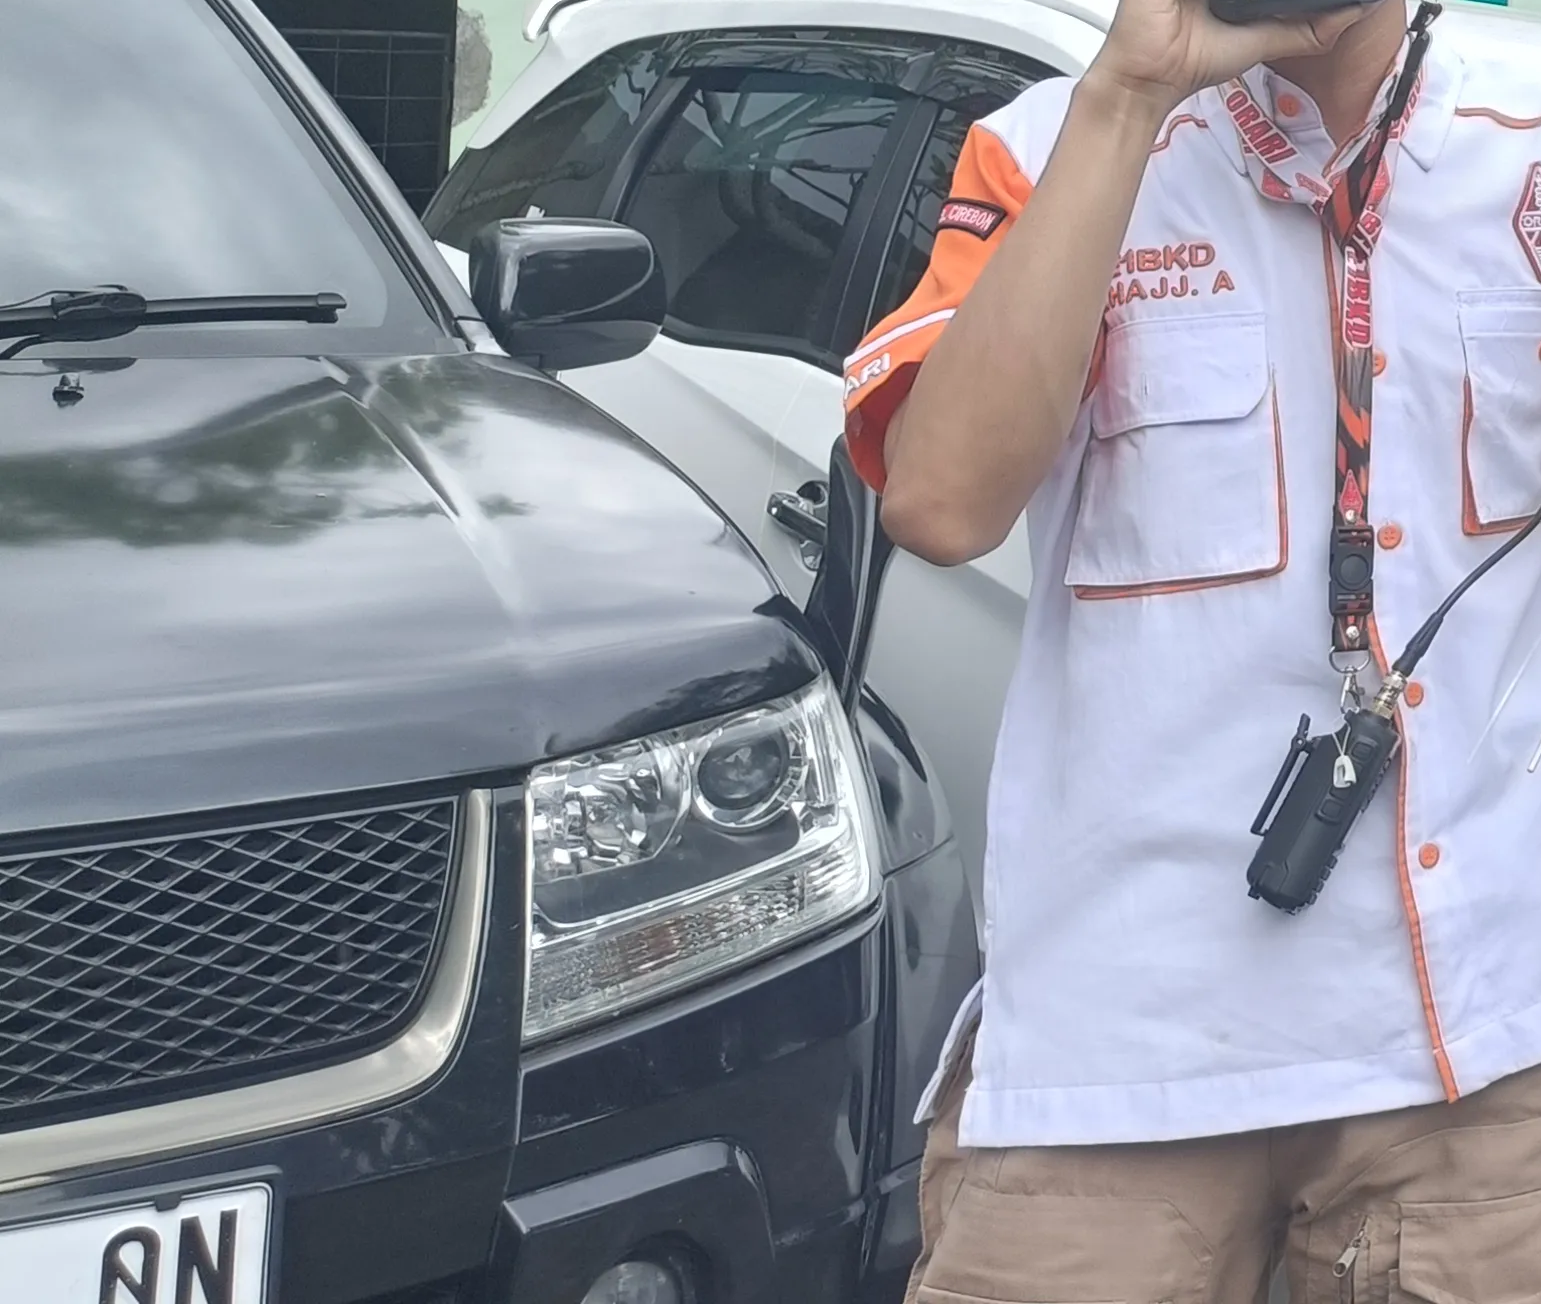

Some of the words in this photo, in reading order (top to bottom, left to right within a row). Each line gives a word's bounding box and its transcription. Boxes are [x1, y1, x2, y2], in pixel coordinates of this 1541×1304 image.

[1225, 90, 1299, 165] ORARI
[1212, 269, 1236, 294] A
[844, 351, 891, 401] ARI
